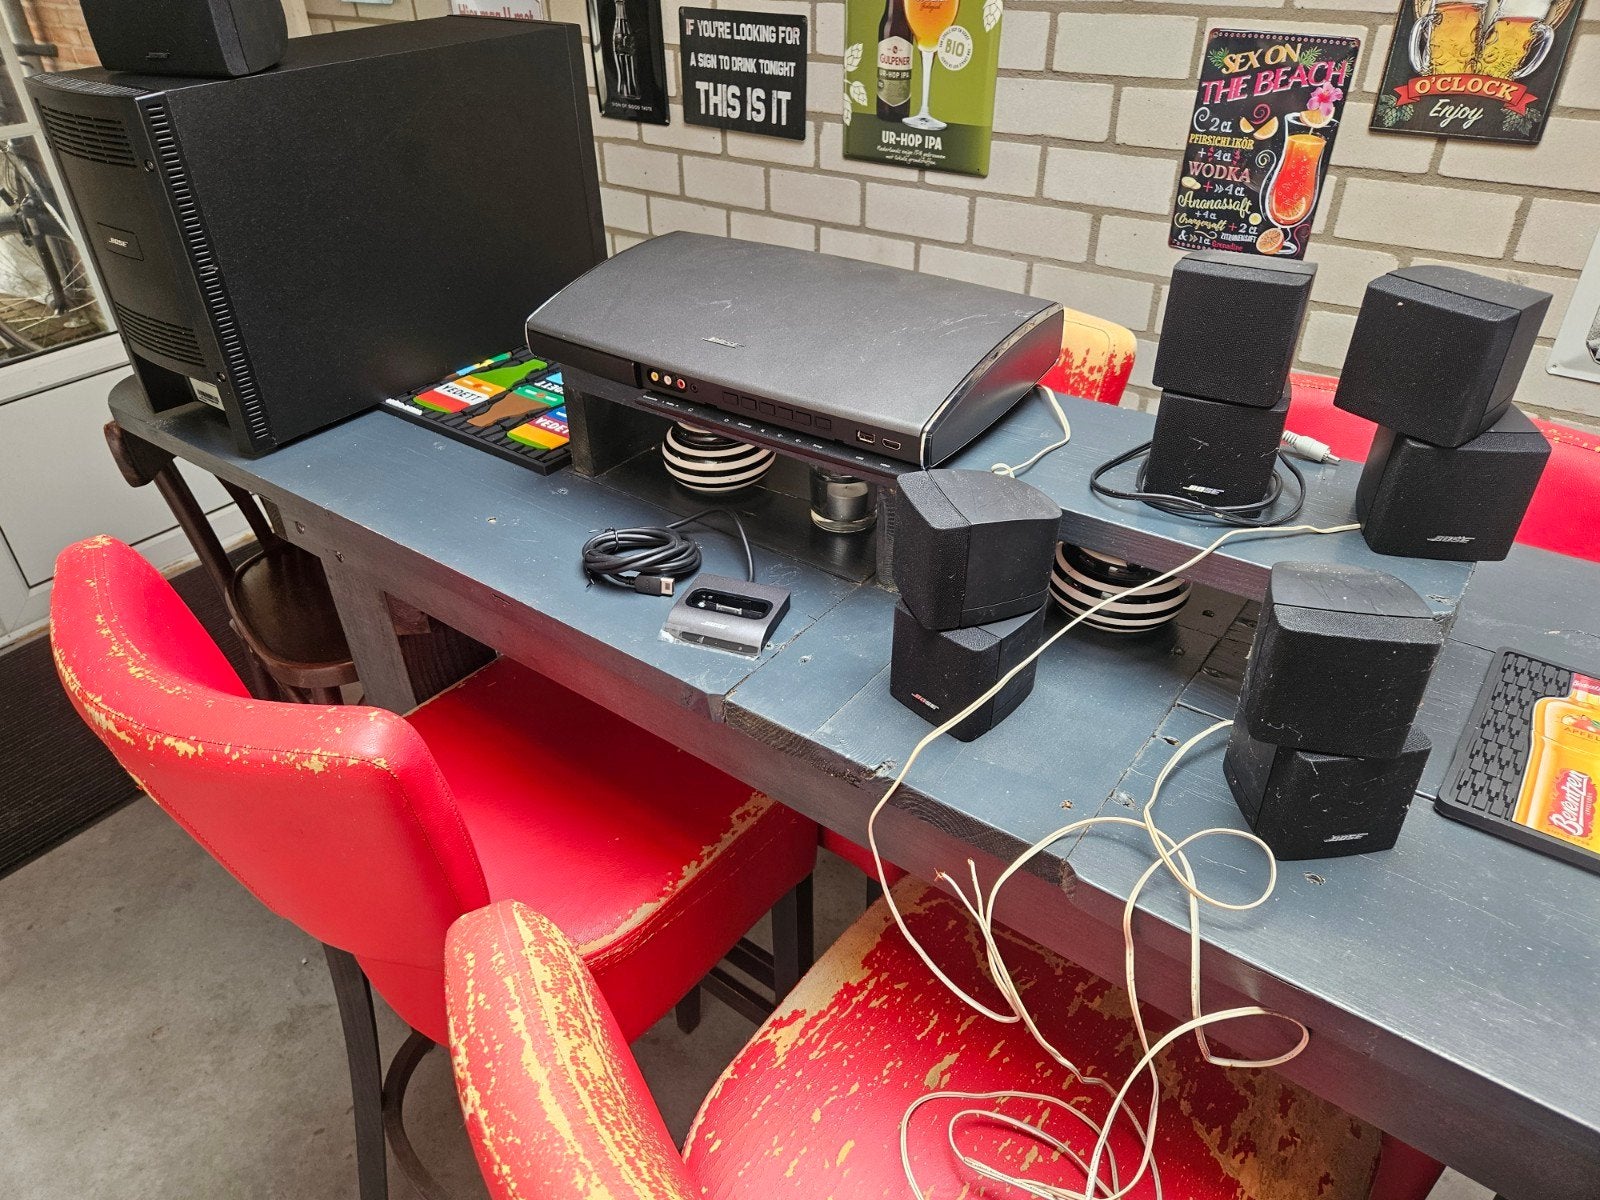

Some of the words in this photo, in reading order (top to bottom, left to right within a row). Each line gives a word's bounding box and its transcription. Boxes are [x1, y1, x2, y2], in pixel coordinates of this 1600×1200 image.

[685, 18, 695, 35] IF
[697, 20, 732, 39] YOU'RE
[733, 22, 776, 43] LOOKING
[778, 26, 800, 45] FOR
[945, 38, 965, 58] BIO
[689, 51, 697, 67] A
[697, 52, 717, 69] SIGN
[718, 54, 730, 71] TO
[731, 56, 757, 73] DRINK
[759, 59, 796, 77] TONIGHT
[879, 53, 911, 66] GULPENER
[1221, 48, 1263, 75] SEX
[1264, 43, 1302, 66] ON
[1201, 74, 1251, 105] THE
[1253, 60, 1350, 97] BEACH
[1415, 76, 1518, 101] O'CLOCK
[695, 80, 741, 119] THIS
[746, 86, 766, 122] IS
[771, 89, 792, 126] IT
[1209, 117, 1220, 131] 2
[1429, 99, 1484, 129] Enjoy
[881, 130, 922, 148] UR-HOP
[924, 135, 943, 150] IPA
[1188, 133, 1255, 150] PFIRSICHLIKÖR
[1214, 149, 1222, 160] 4
[1188, 161, 1251, 183] WODKA
[1225, 184, 1234, 195] 4
[1178, 190, 1253, 219] Ananassaft
[1202, 210, 1209, 219] 4
[1178, 212, 1227, 232] Orangensaft
[1238, 223, 1248, 233] 2
[109, 237, 129, 248] BOSE
[441, 384, 485, 402] VEDETT
[1549, 770, 1589, 836] Berentzen
